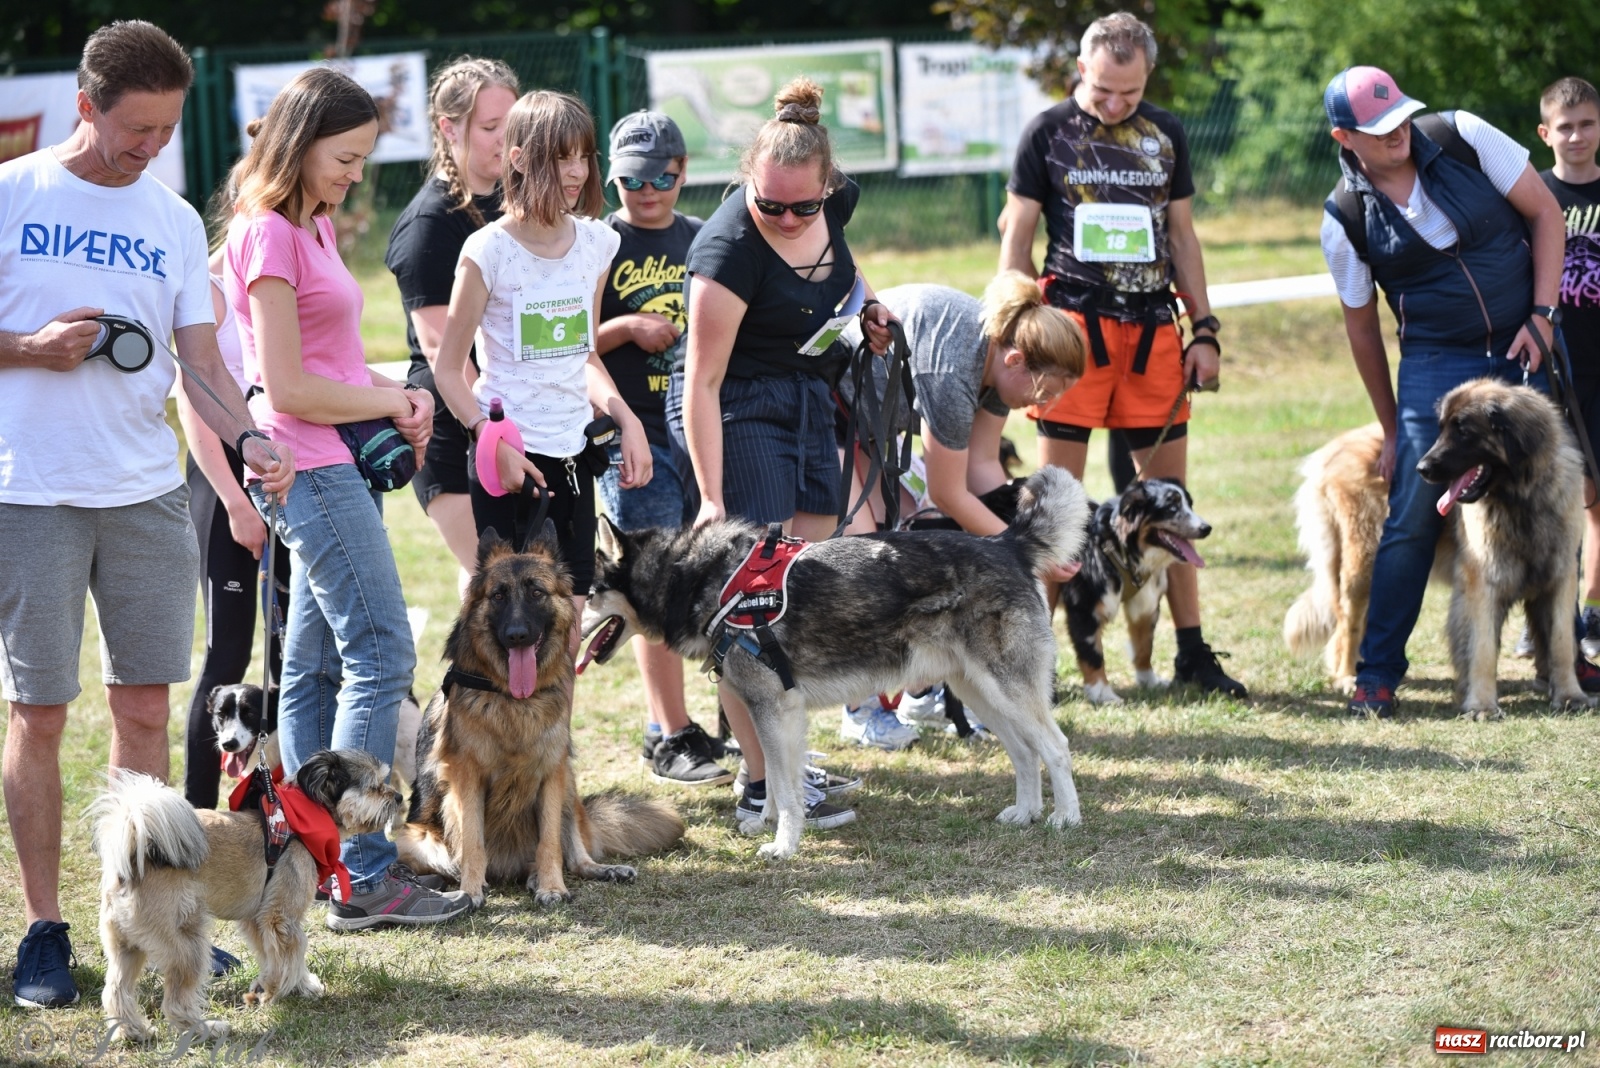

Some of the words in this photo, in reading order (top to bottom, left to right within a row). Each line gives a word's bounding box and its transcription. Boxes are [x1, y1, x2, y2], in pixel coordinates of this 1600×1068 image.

[1067, 169, 1168, 187] RUNMAGEDDON
[1105, 233, 1128, 250] 18
[20, 223, 166, 279] DIVERSE
[525, 296, 583, 311] DOGTREKKING
[552, 322, 566, 342] 6
